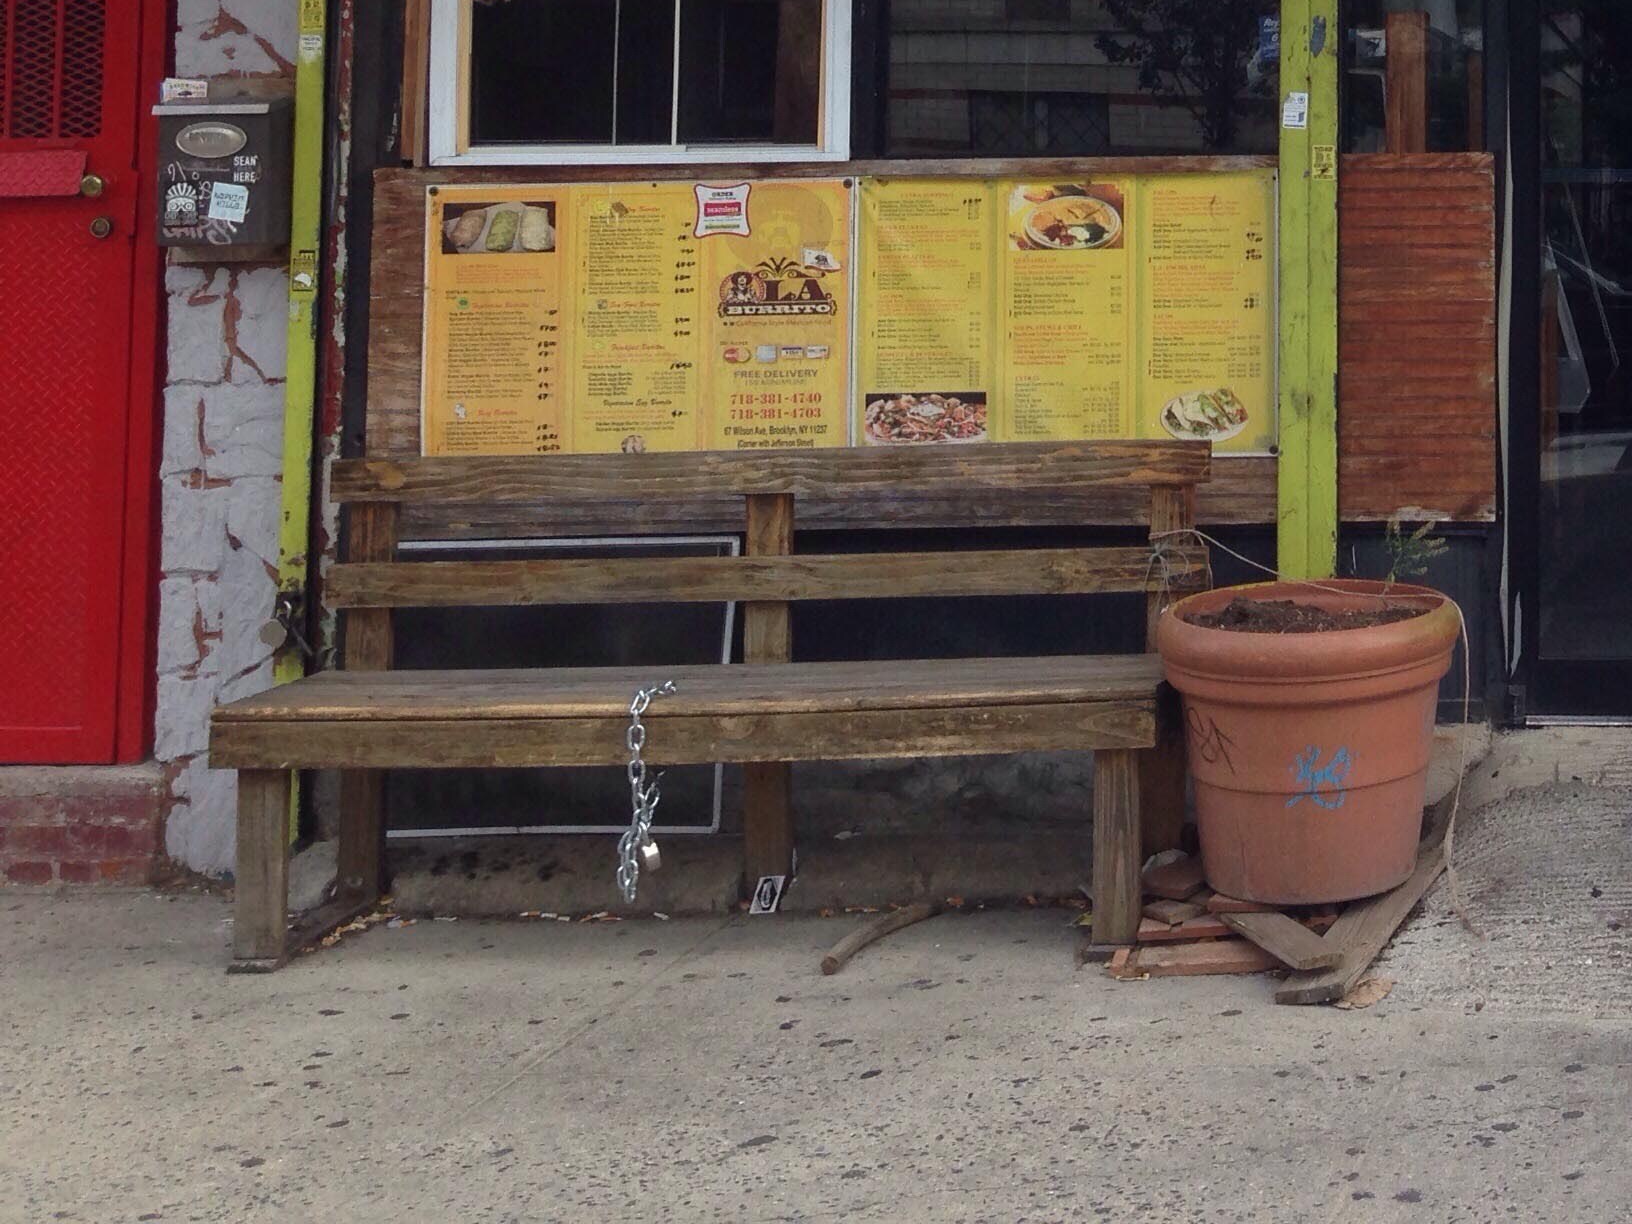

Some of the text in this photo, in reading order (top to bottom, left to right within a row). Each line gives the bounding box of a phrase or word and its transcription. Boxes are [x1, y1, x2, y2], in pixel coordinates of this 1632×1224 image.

[727, 305, 831, 315] BURRITO
[734, 369, 818, 378] FREE DELIVERY
[731, 393, 821, 404] 718-381-4740
[731, 408, 821, 419] 718-381-4703
